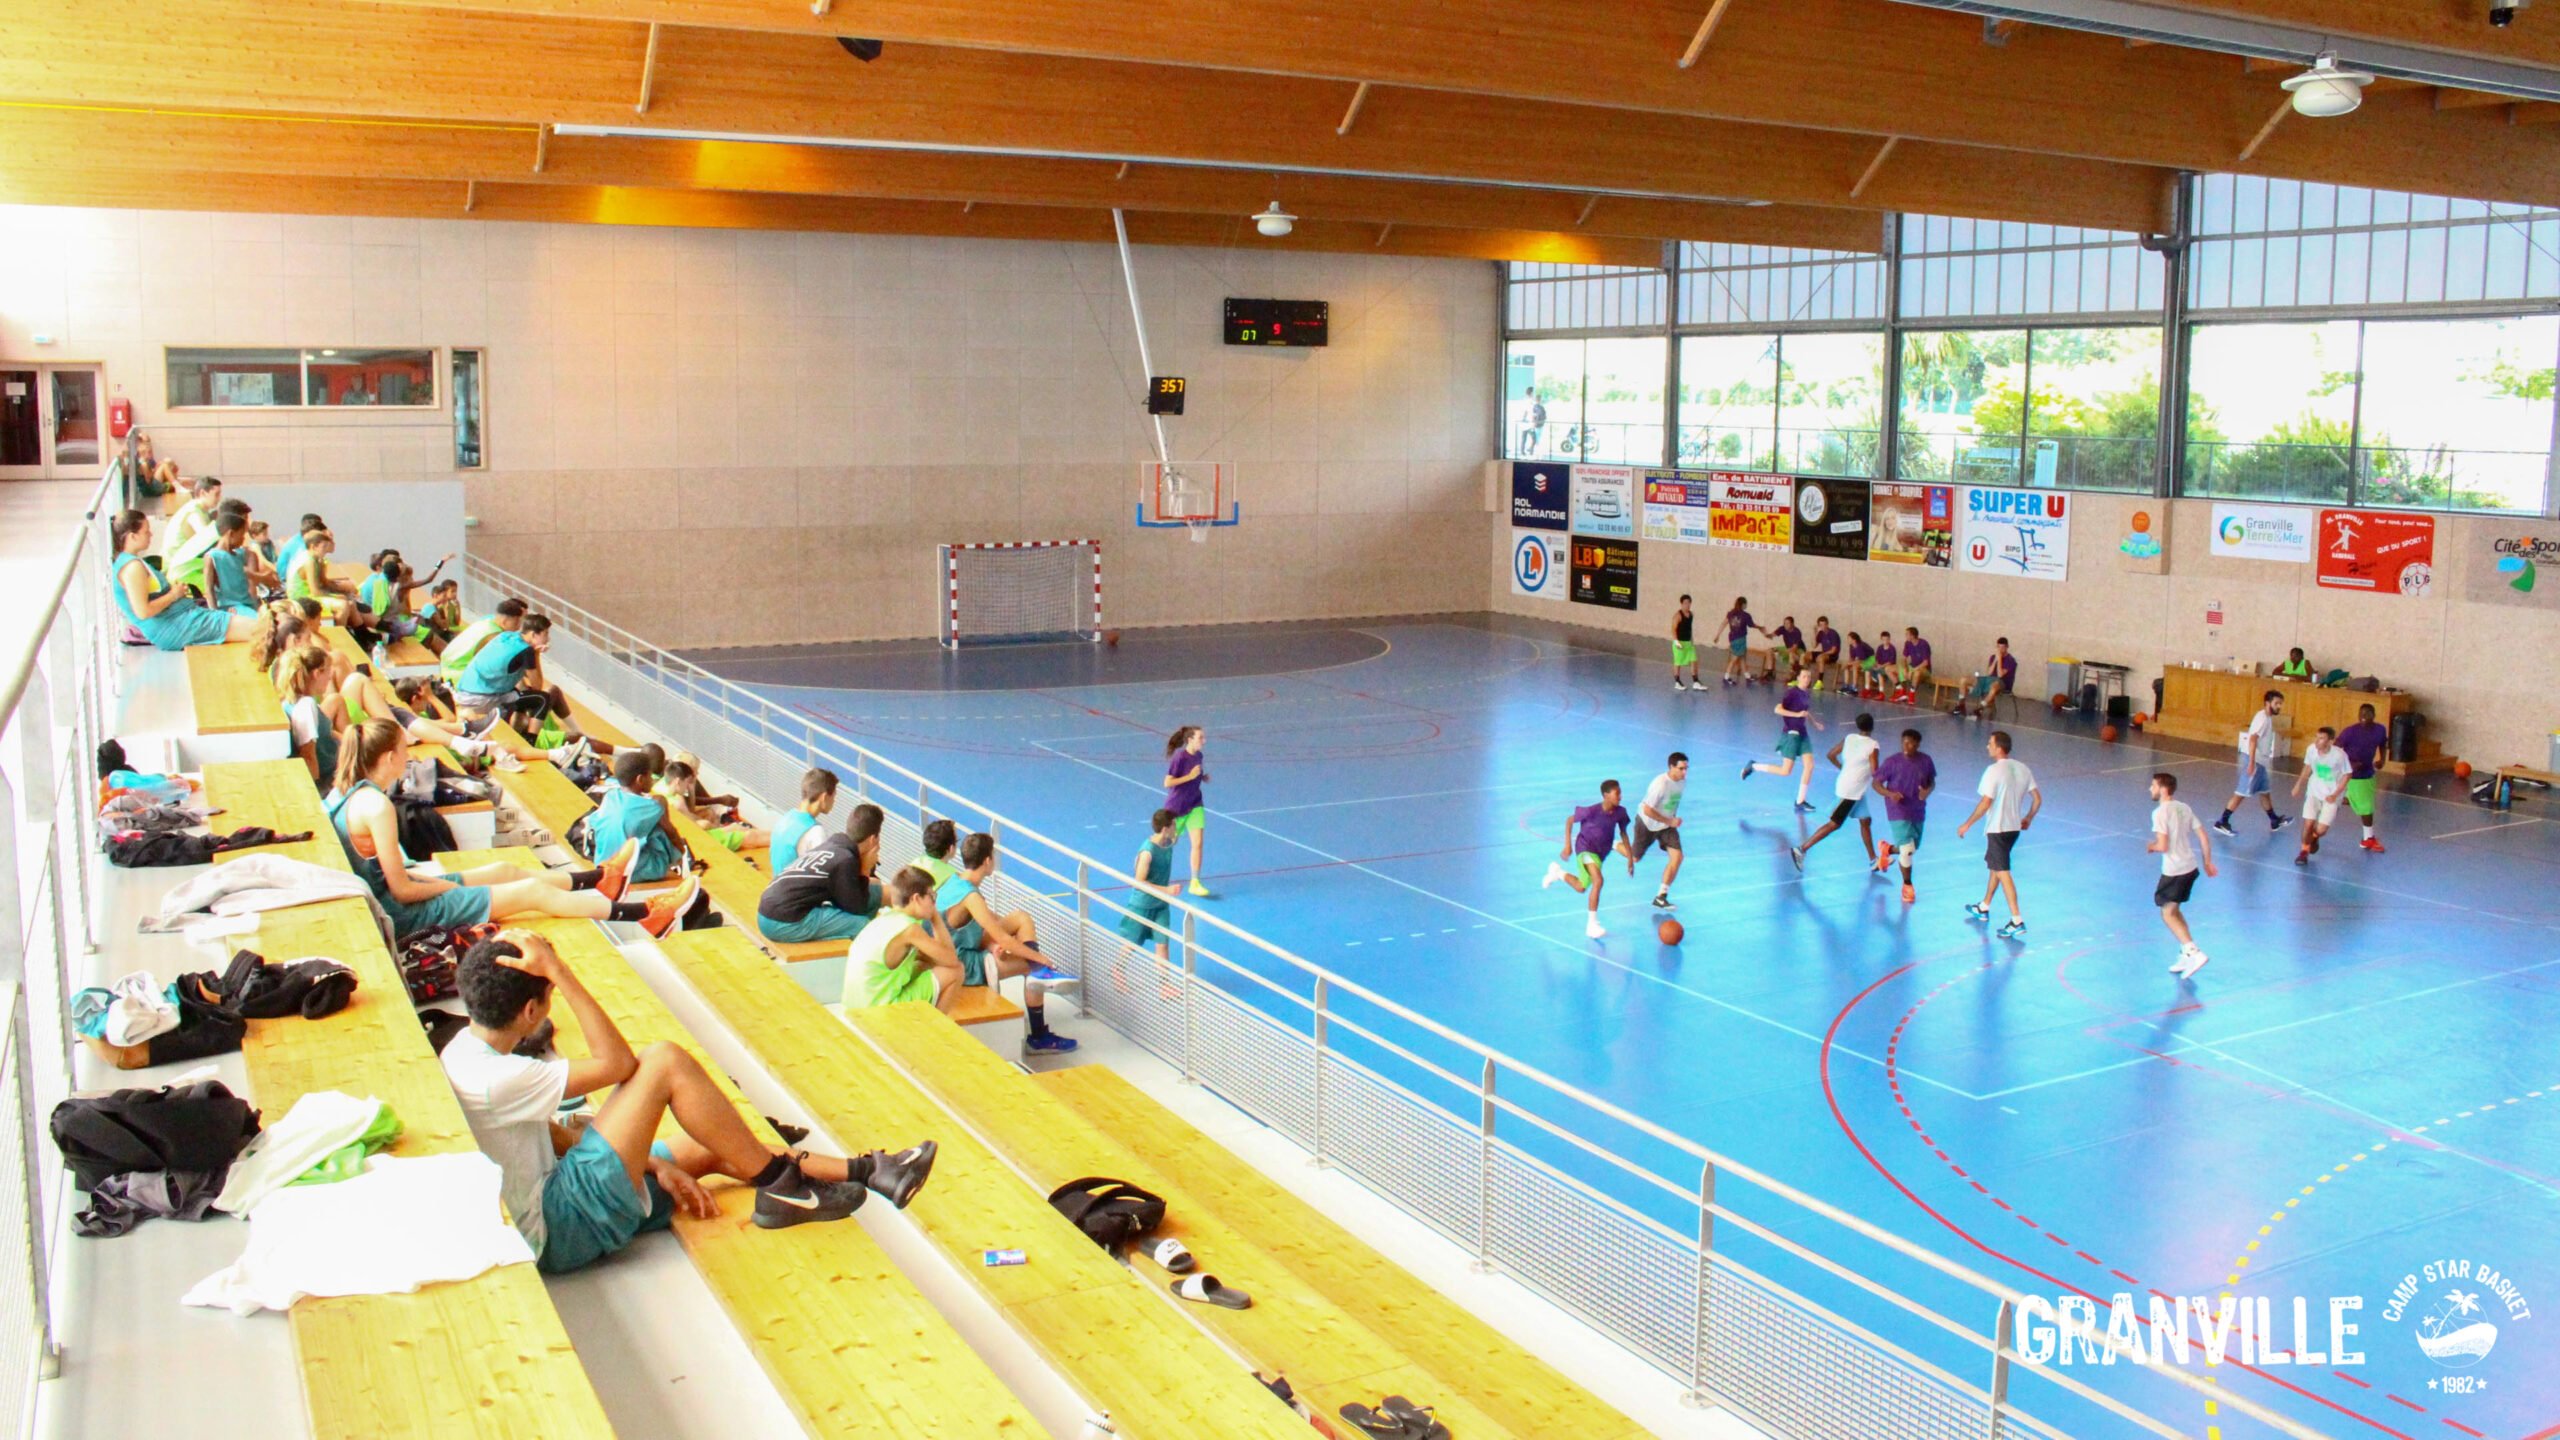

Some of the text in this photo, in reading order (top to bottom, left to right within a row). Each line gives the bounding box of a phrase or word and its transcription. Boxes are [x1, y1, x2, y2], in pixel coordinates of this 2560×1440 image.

[1660, 485, 1680, 493] Patrick
[1726, 486, 1775, 501] Romuald
[1968, 489, 2042, 516] SUPER
[2047, 495, 2065, 518] U
[1514, 508, 1566, 520] NORMANDIE
[2335, 513, 2364, 526] GRANVILLE
[2246, 517, 2293, 532] Granville
[1606, 546, 1637, 558] Bâtiment
[1972, 544, 1985, 560] U
[2376, 545, 2390, 554] QUE
[2391, 542, 2400, 550] DU
[2402, 536, 2422, 548] SPORT
[2494, 538, 2521, 554] Cité
[2518, 547, 2536, 558] des
